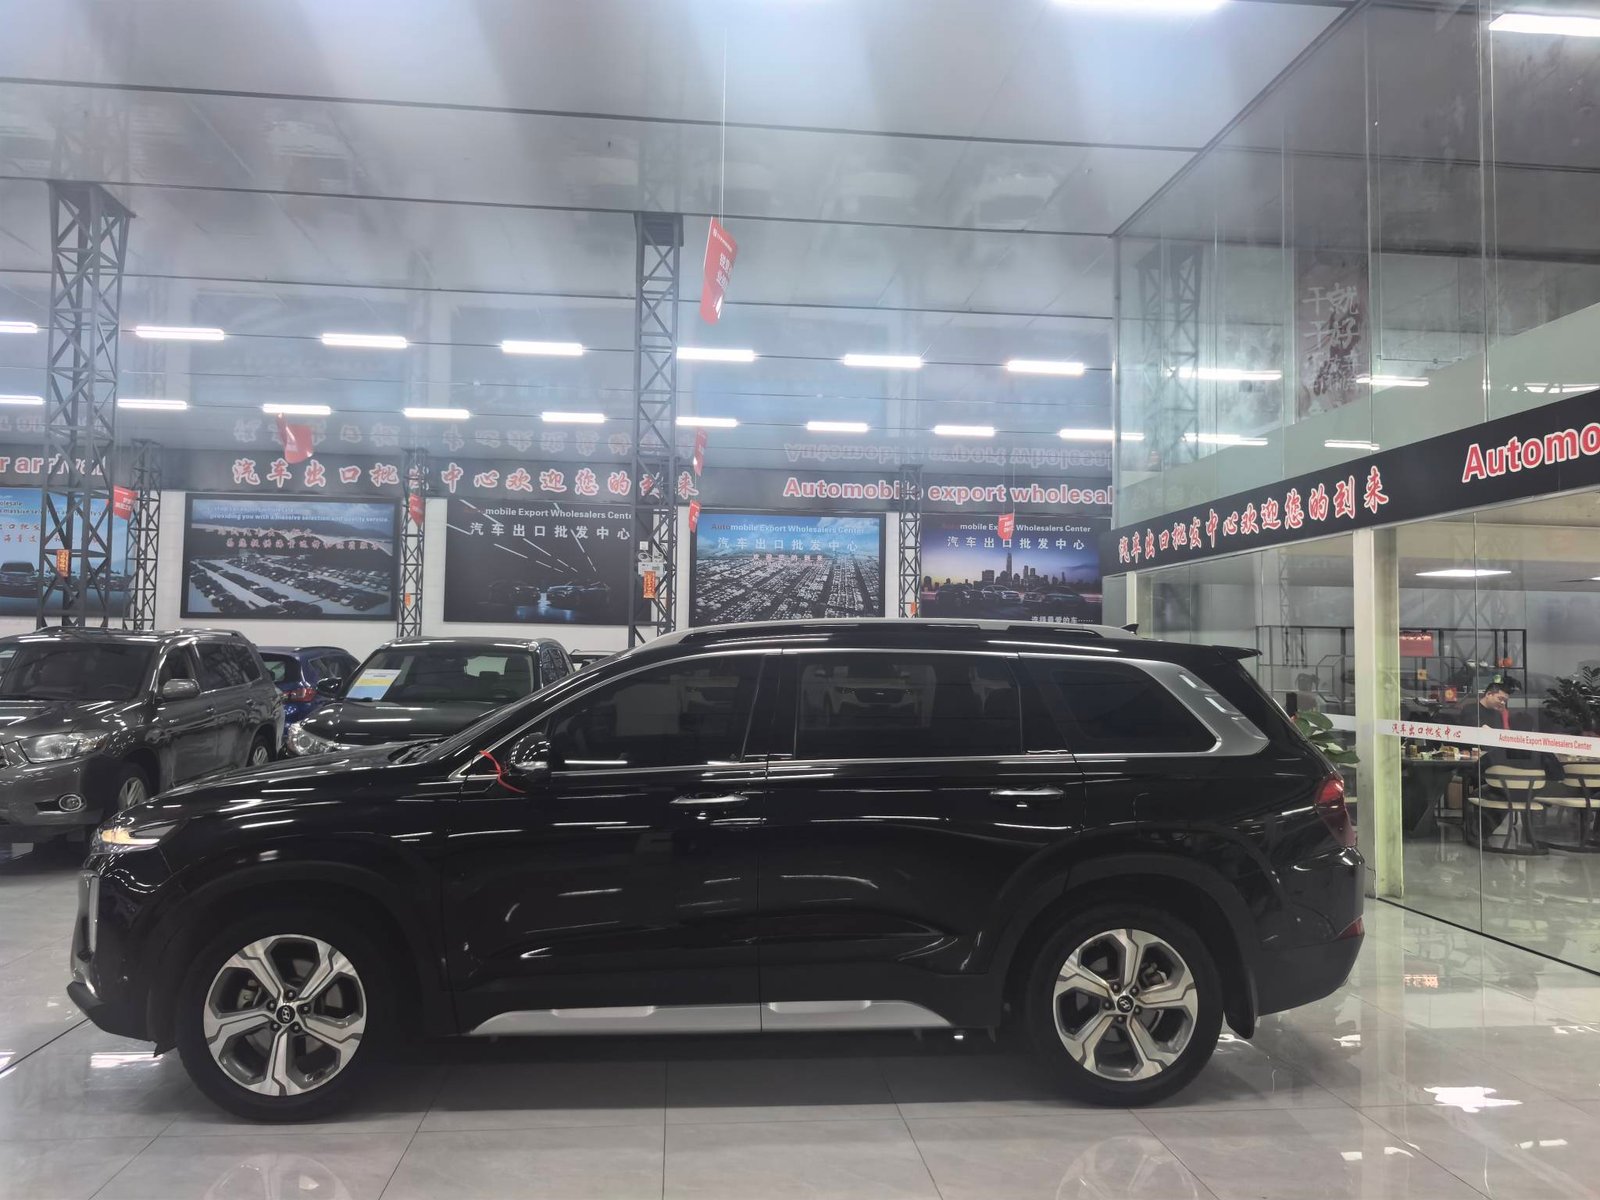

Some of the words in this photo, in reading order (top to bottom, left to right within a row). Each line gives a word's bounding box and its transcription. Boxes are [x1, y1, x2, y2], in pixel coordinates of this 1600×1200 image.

[1462, 422, 1600, 483] Automo
[928, 484, 1006, 504] export
[518, 508, 549, 518] Export
[551, 509, 606, 519] Wholesalers
[1118, 465, 1389, 564] 汽车出口批发中心欢迎您的到来
[470, 522, 630, 540] 汽车出口批发中心
[1065, 524, 1092, 533] Center
[718, 536, 858, 552] 汽车出口批发中心
[947, 535, 1085, 550] 汽车出口批发中心
